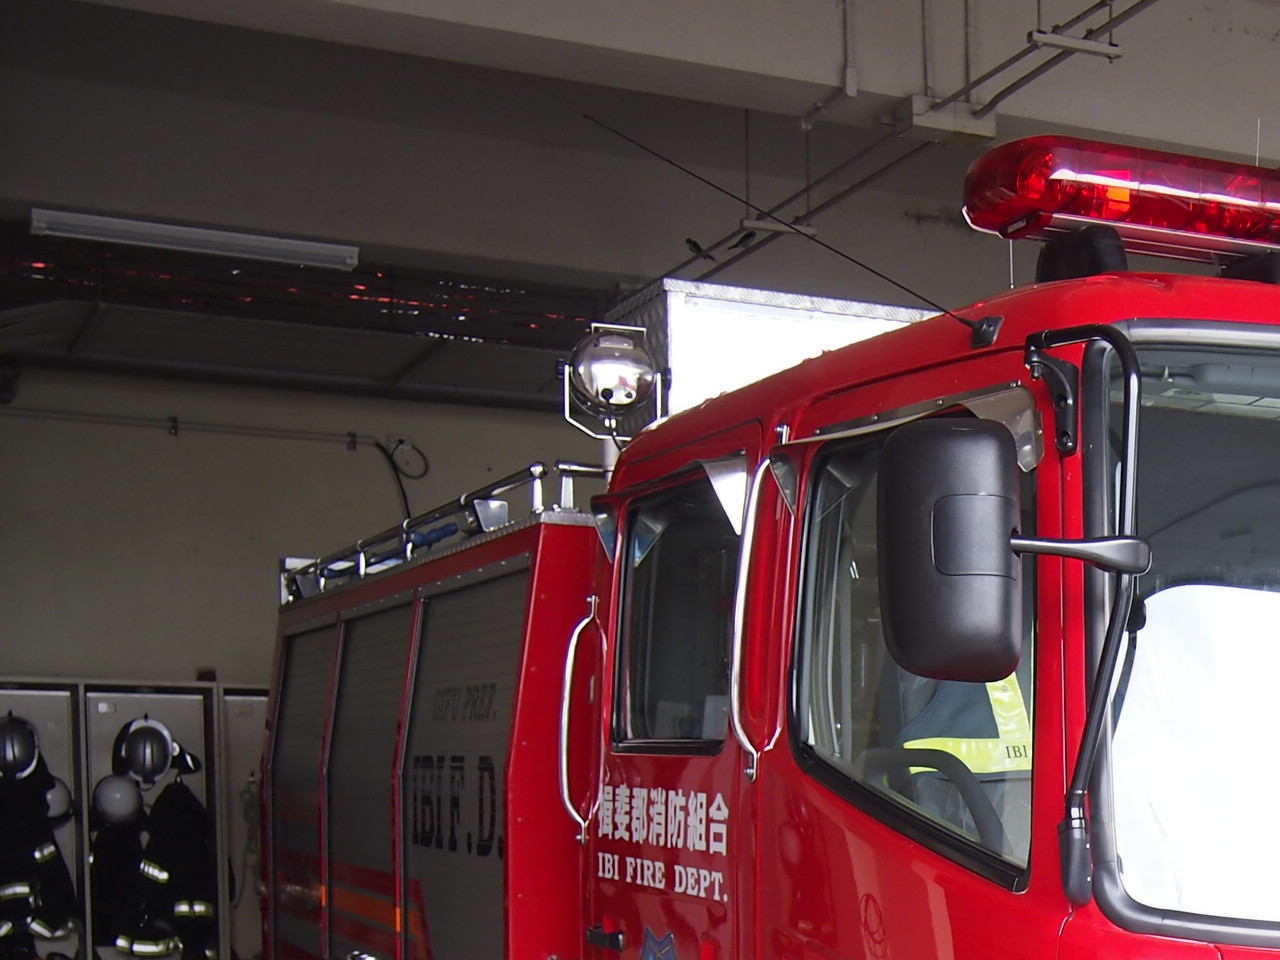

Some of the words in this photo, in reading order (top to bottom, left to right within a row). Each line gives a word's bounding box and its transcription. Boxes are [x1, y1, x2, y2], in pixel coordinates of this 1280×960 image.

[1005, 745, 1028, 759] IBI
[412, 755, 446, 849] IBI
[598, 852, 620, 881] IBI
[625, 856, 666, 889] FIRE
[674, 864, 728, 902] DEPT.
